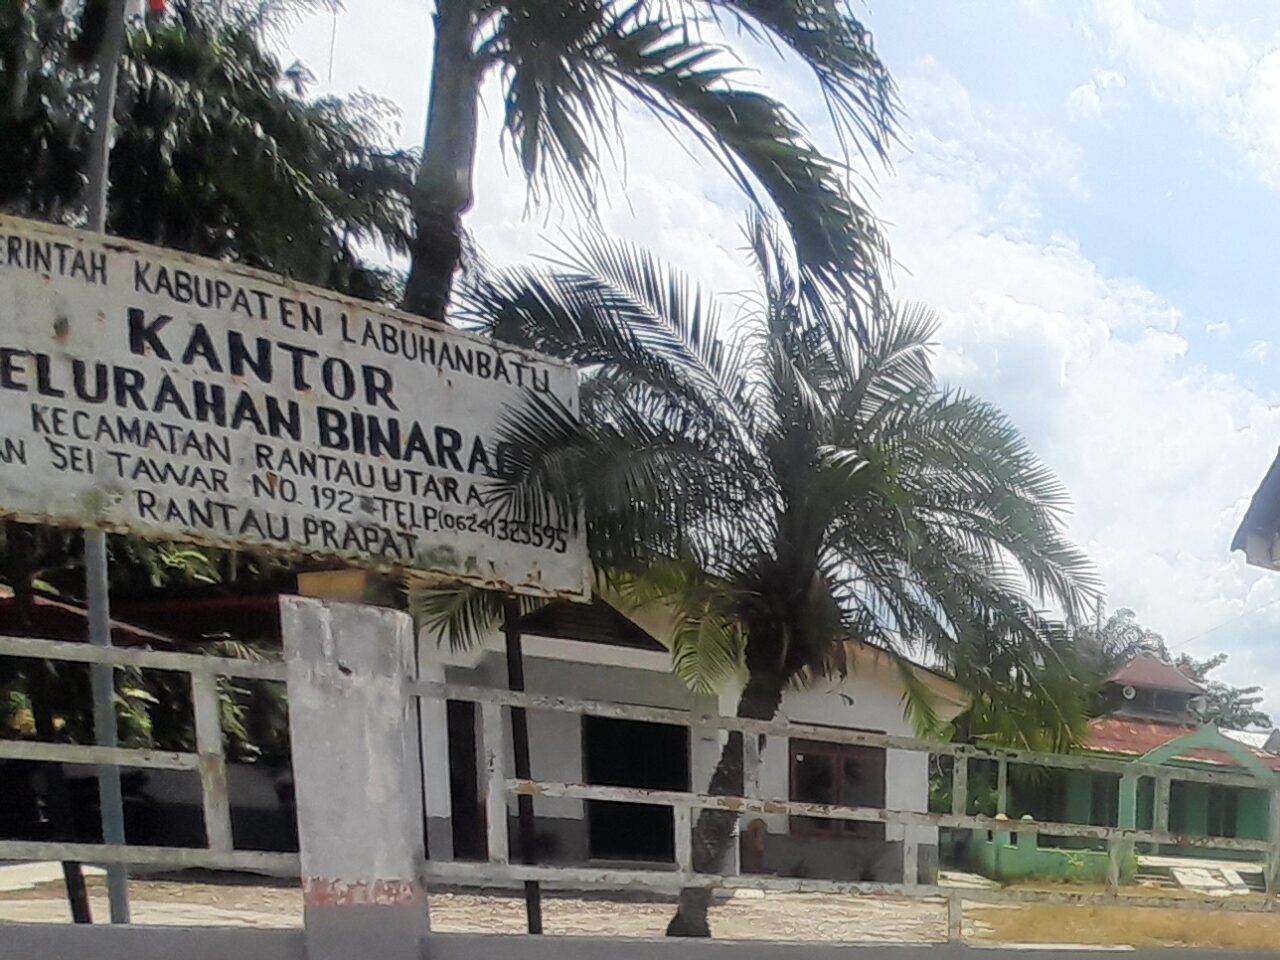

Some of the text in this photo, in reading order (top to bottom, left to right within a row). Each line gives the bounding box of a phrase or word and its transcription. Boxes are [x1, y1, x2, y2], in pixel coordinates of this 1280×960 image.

[0, 234, 549, 393] RINTAH KABUPATEN LABUHANBATU
[127, 307, 399, 410] KANTOR
[0, 347, 300, 442] ELURAHAN
[31, 403, 485, 508] KECAMATAN RANTAU UTARA
[44, 436, 94, 474] SEI
[106, 451, 229, 494] TAWAR
[138, 489, 419, 560] RANTAU PRAPAT
